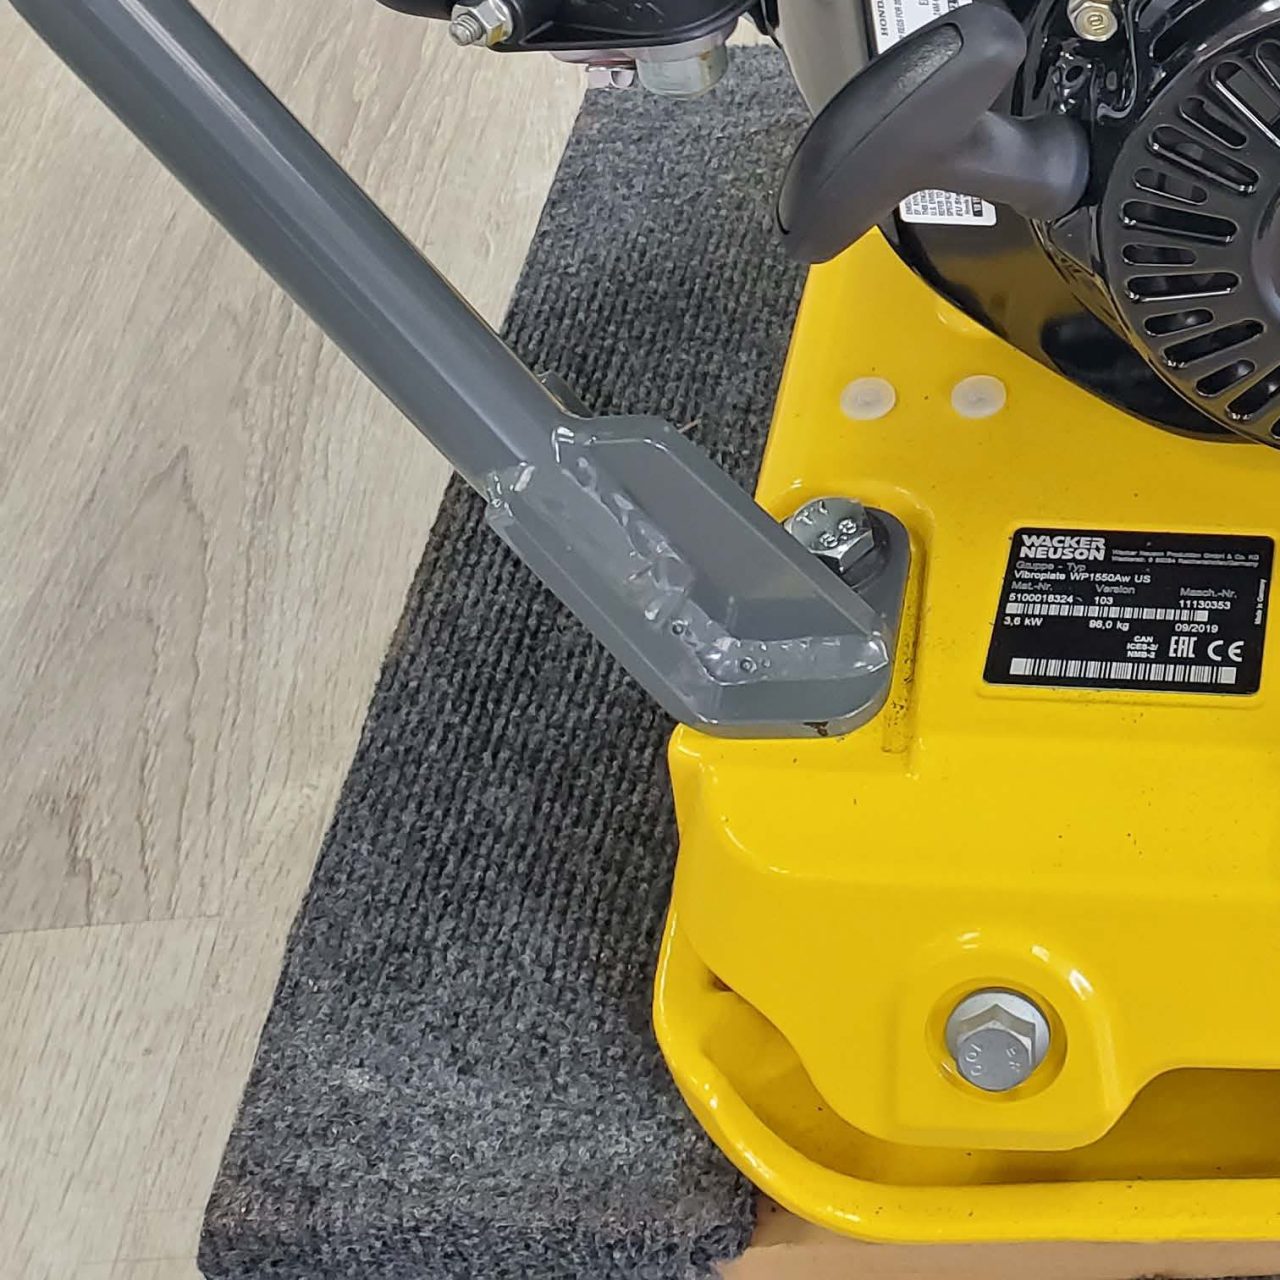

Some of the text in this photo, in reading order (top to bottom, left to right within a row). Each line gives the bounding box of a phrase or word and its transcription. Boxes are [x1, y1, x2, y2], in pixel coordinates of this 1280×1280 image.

[1022, 534, 1106, 549] WACKER
[1019, 546, 1105, 560] NEUSON
[1066, 562, 1086, 572] Typ
[1014, 570, 1151, 583] Vibroplate WP1550Aw US
[1011, 581, 1053, 591] Mat.-Nr.
[1096, 584, 1135, 595] Version
[1094, 596, 1113, 605] 103
[1179, 600, 1231, 610] 11130353
[1003, 616, 1021, 626] 3,6
[1024, 617, 1043, 626] kW
[1116, 621, 1130, 631] kg
[1175, 623, 1219, 633] 09/2019
[1134, 635, 1153, 643] CAN
[1207, 640, 1244, 662] CE
